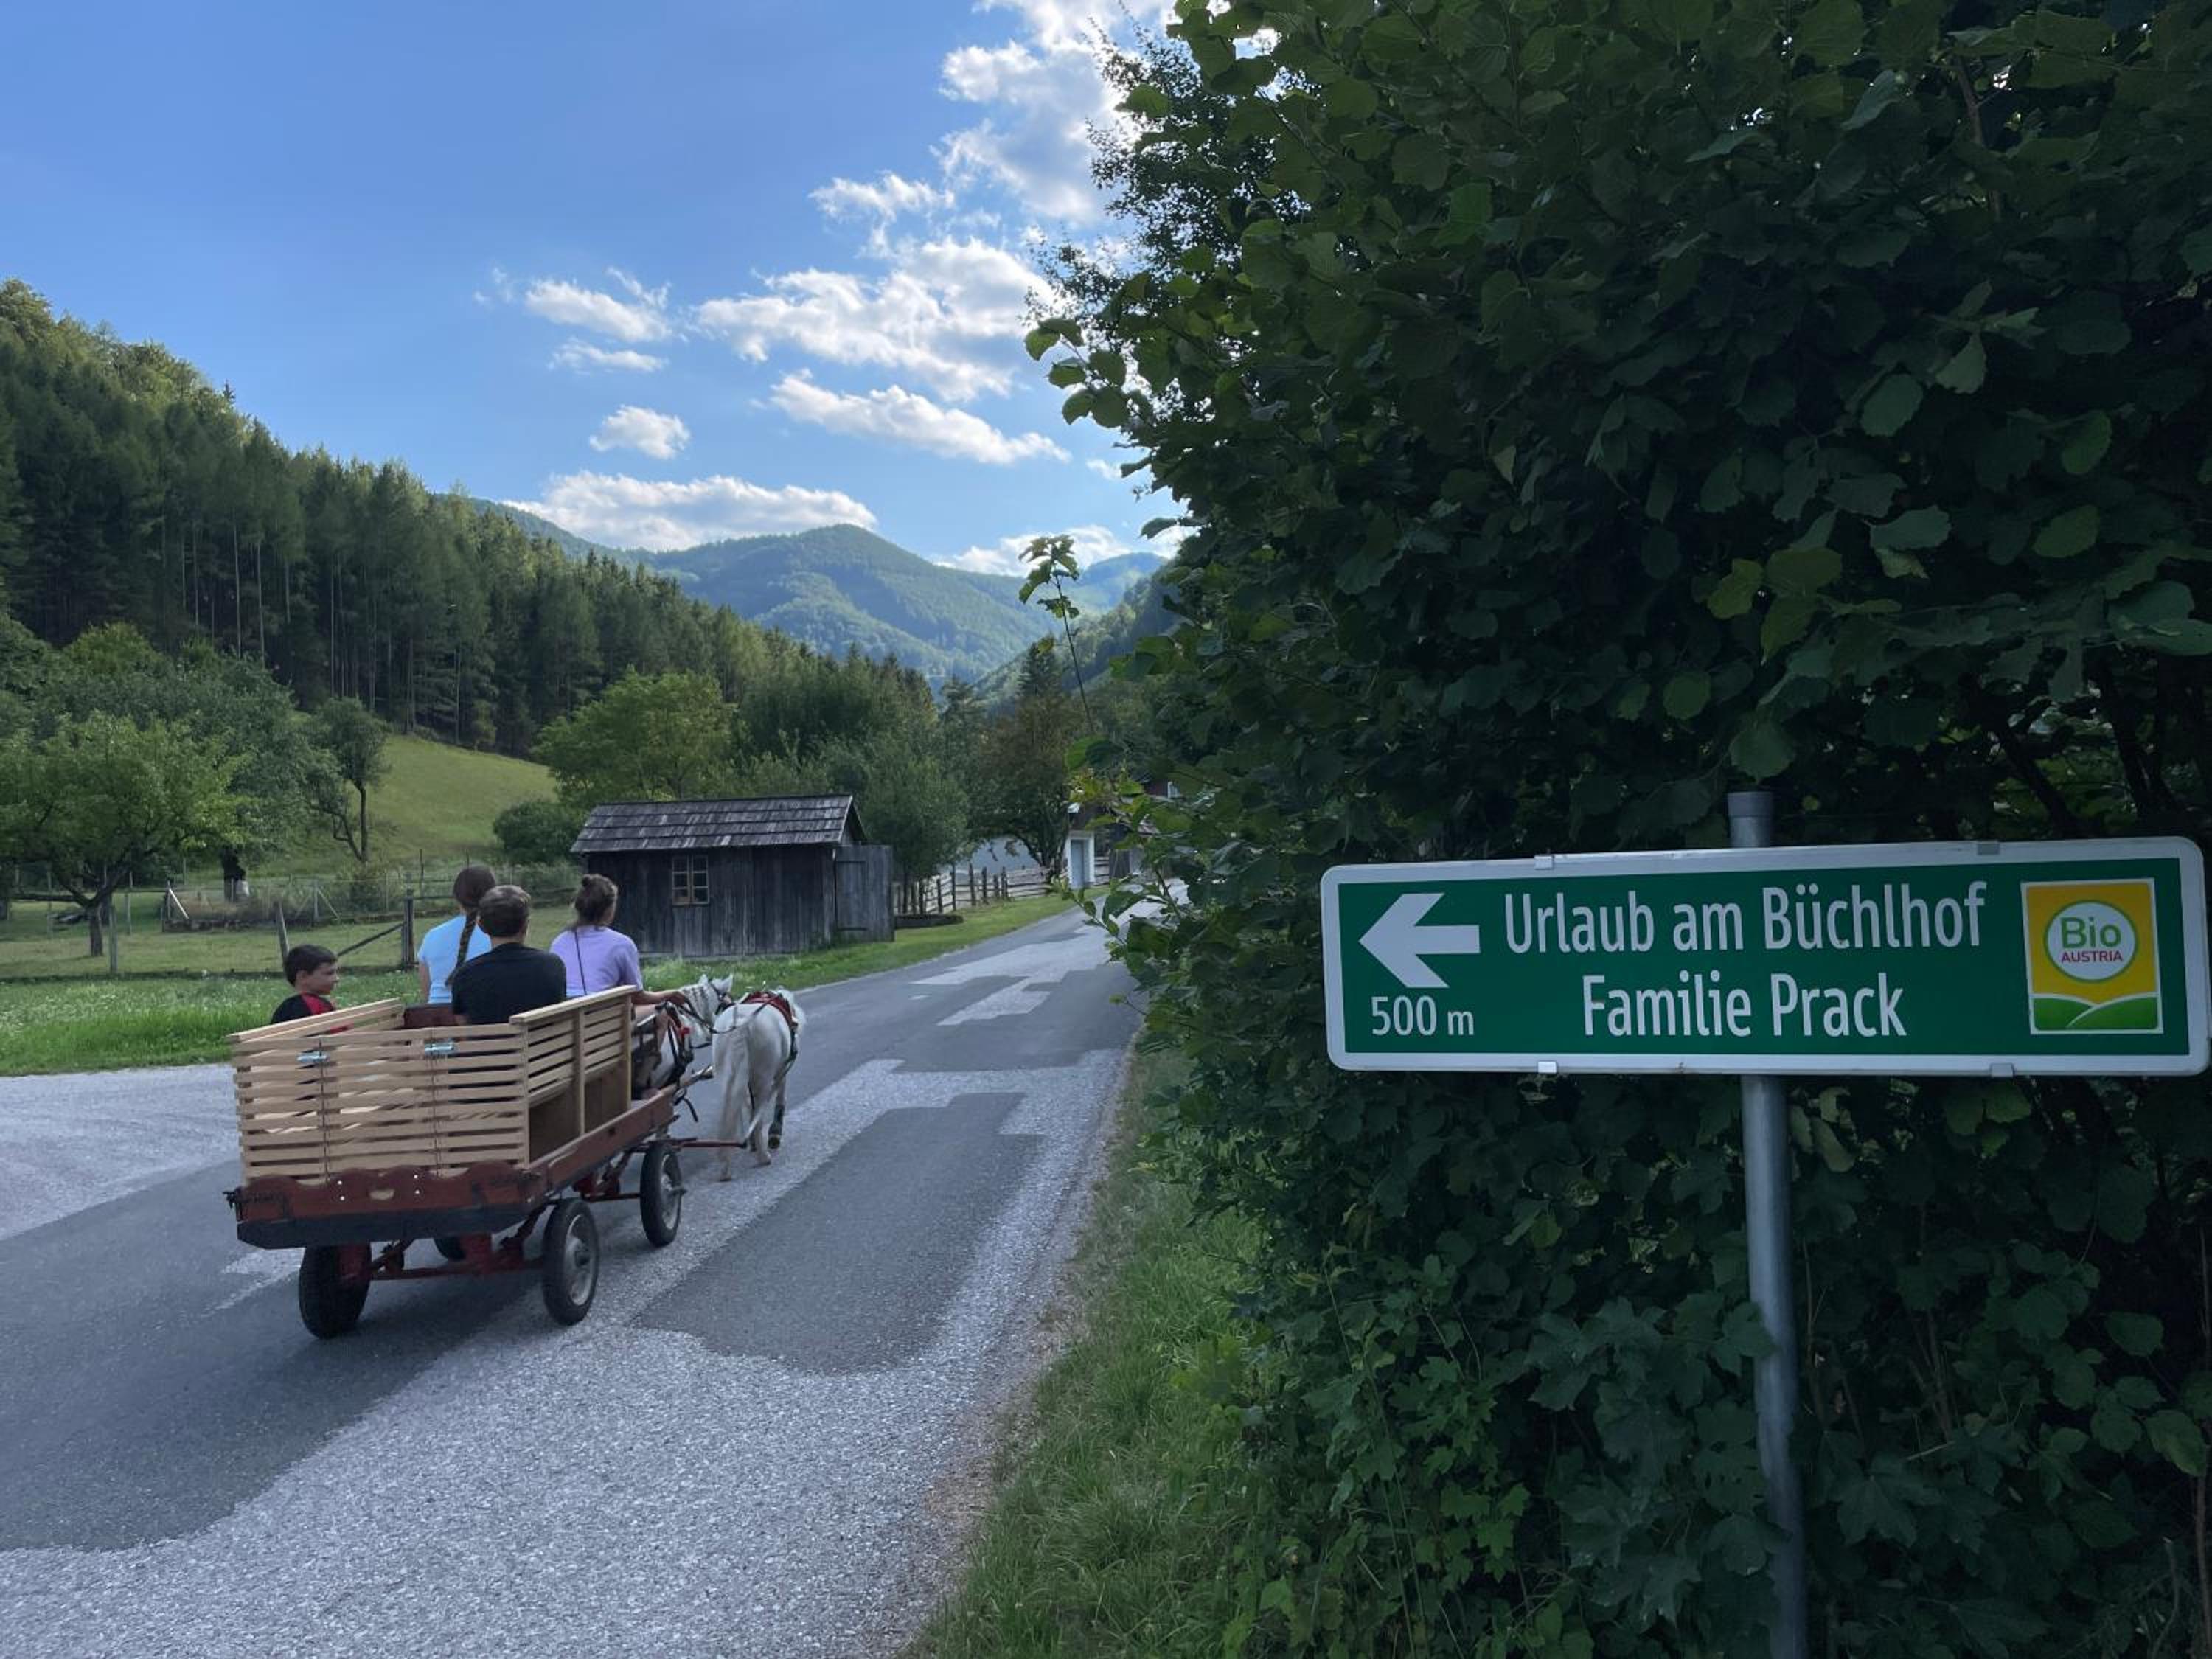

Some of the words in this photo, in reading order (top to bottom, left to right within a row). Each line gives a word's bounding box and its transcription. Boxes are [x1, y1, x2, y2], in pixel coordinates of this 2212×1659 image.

[1505, 891, 1654, 953] Urlaub
[1673, 903, 1743, 952] am
[1763, 882, 1986, 950] Büchlhof
[2060, 917, 2121, 949] Bio
[2061, 950, 2124, 963] AUSTRIA
[1371, 995, 1437, 1036] 500
[1447, 1010, 1474, 1035] m
[1583, 970, 1751, 1037] Familie
[1770, 973, 1907, 1037] Prack
